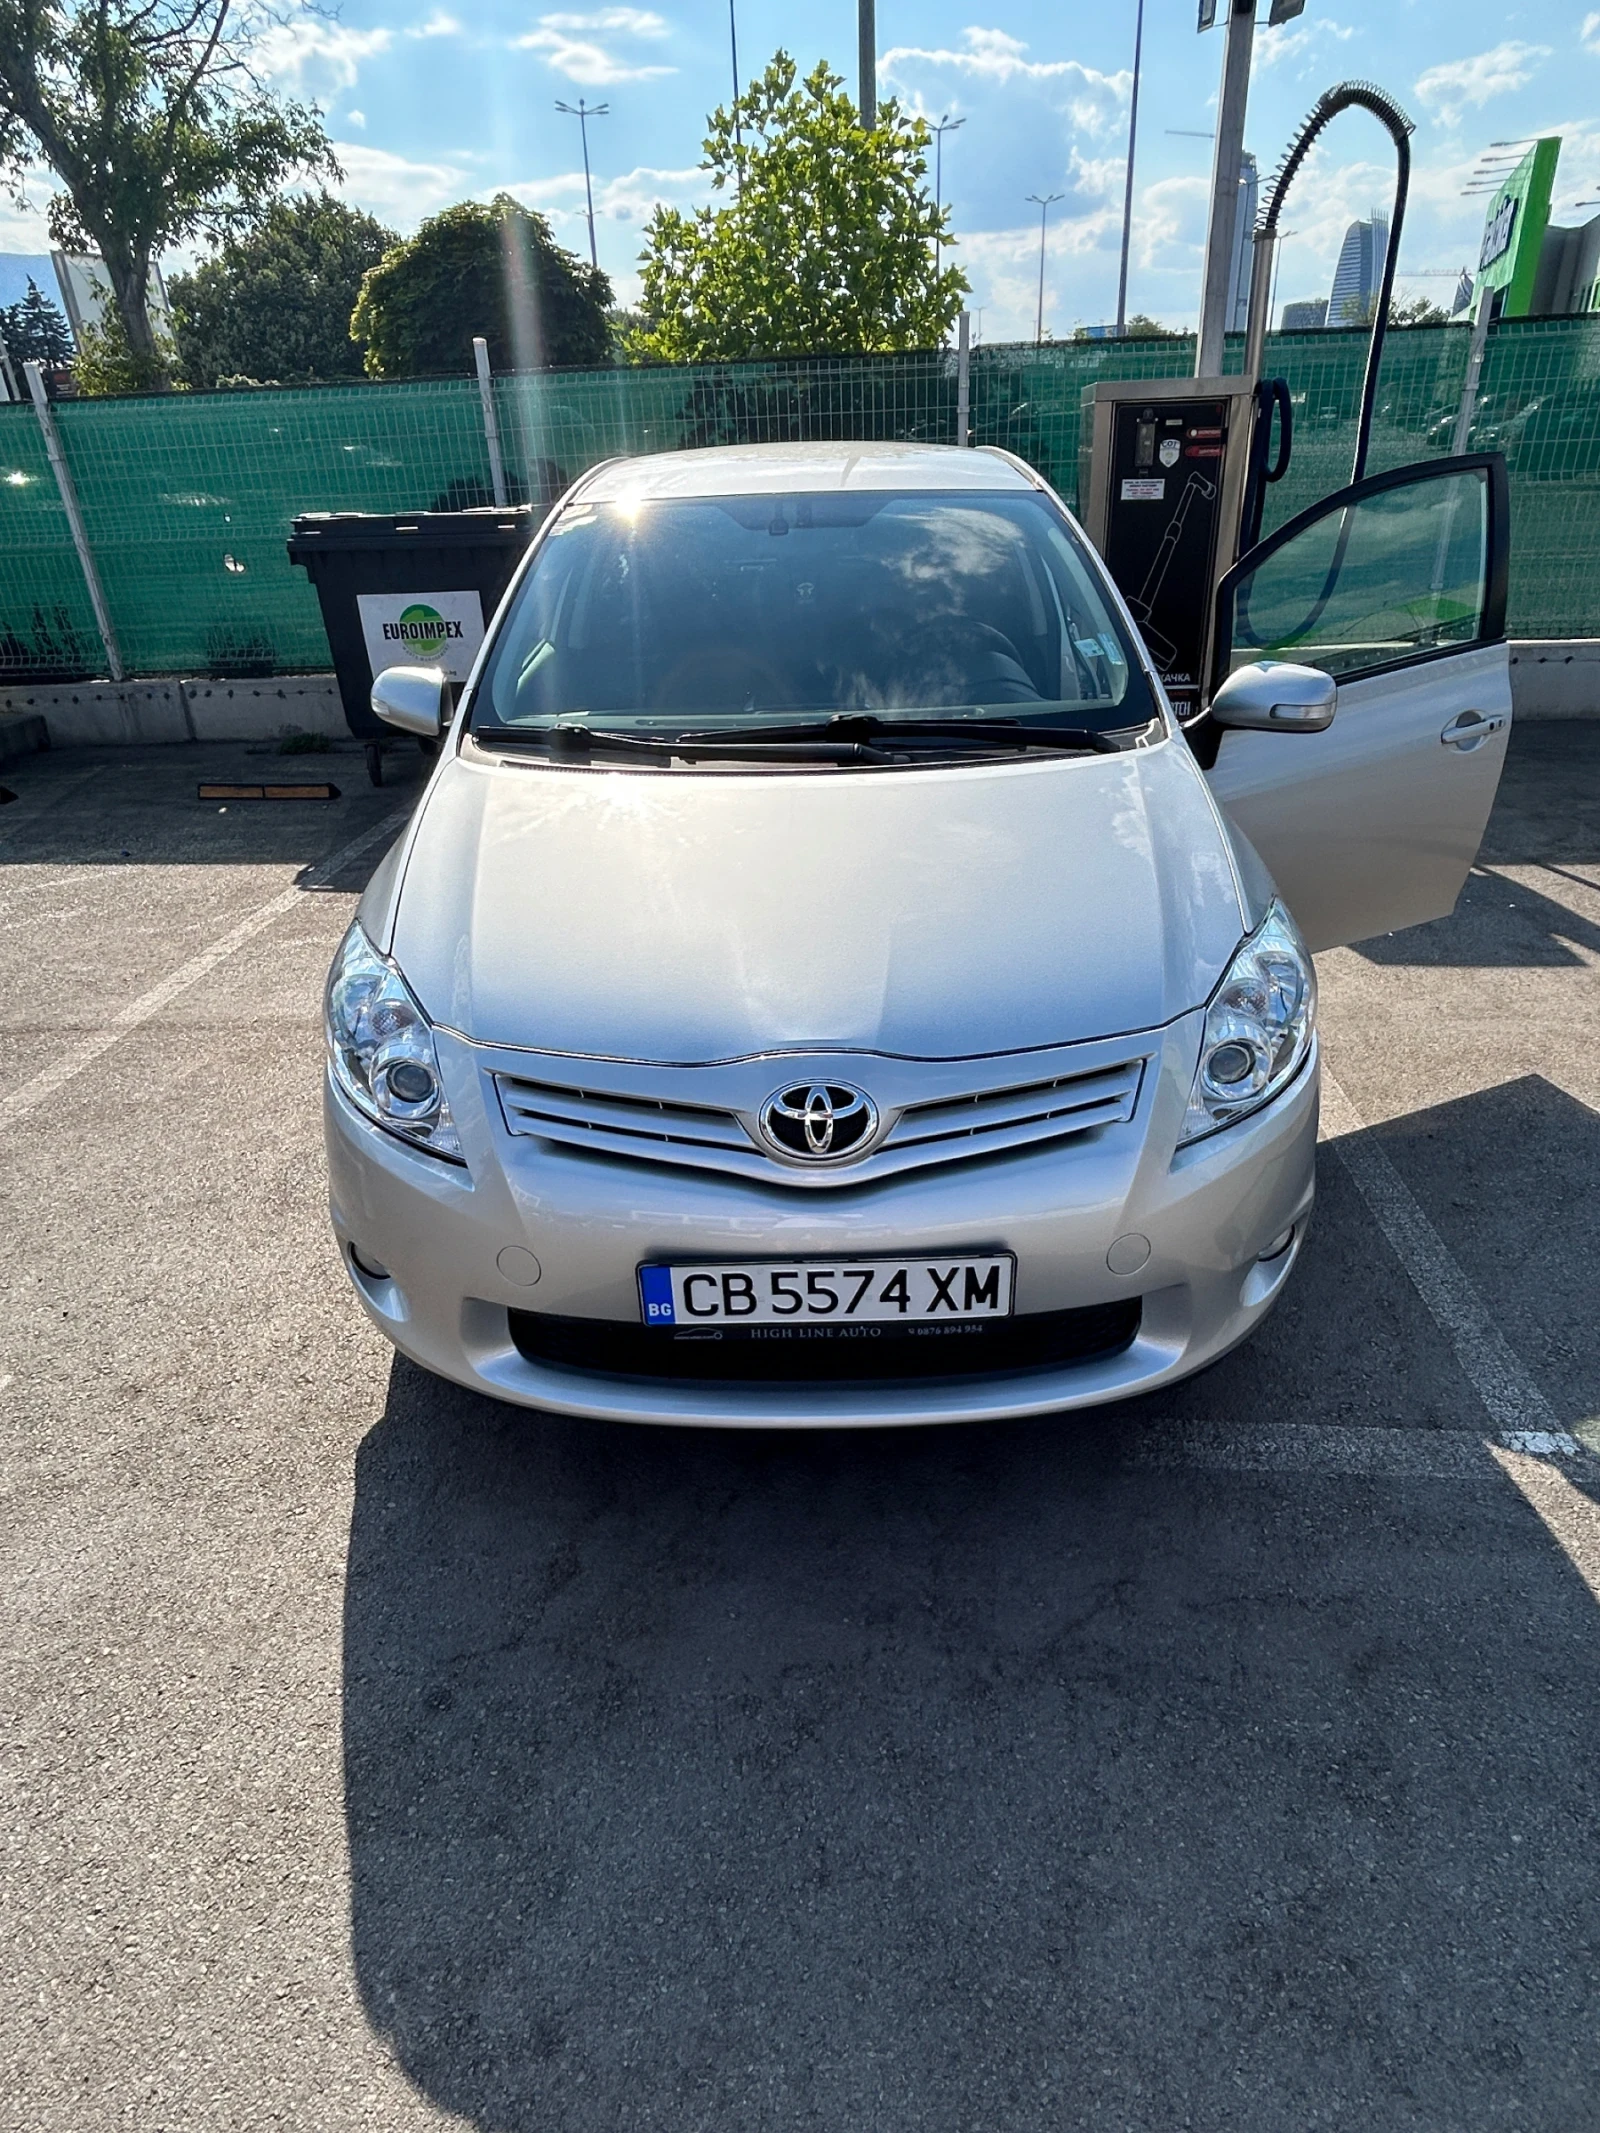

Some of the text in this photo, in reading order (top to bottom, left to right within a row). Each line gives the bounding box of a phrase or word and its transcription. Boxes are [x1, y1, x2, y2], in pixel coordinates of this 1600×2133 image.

[382, 621, 464, 640] EUROIMPEX
[682, 1265, 1001, 1318] CB 5574 XM
[648, 1303, 672, 1317] BG
[750, 1326, 882, 1338] HIGH LINE AUTO
